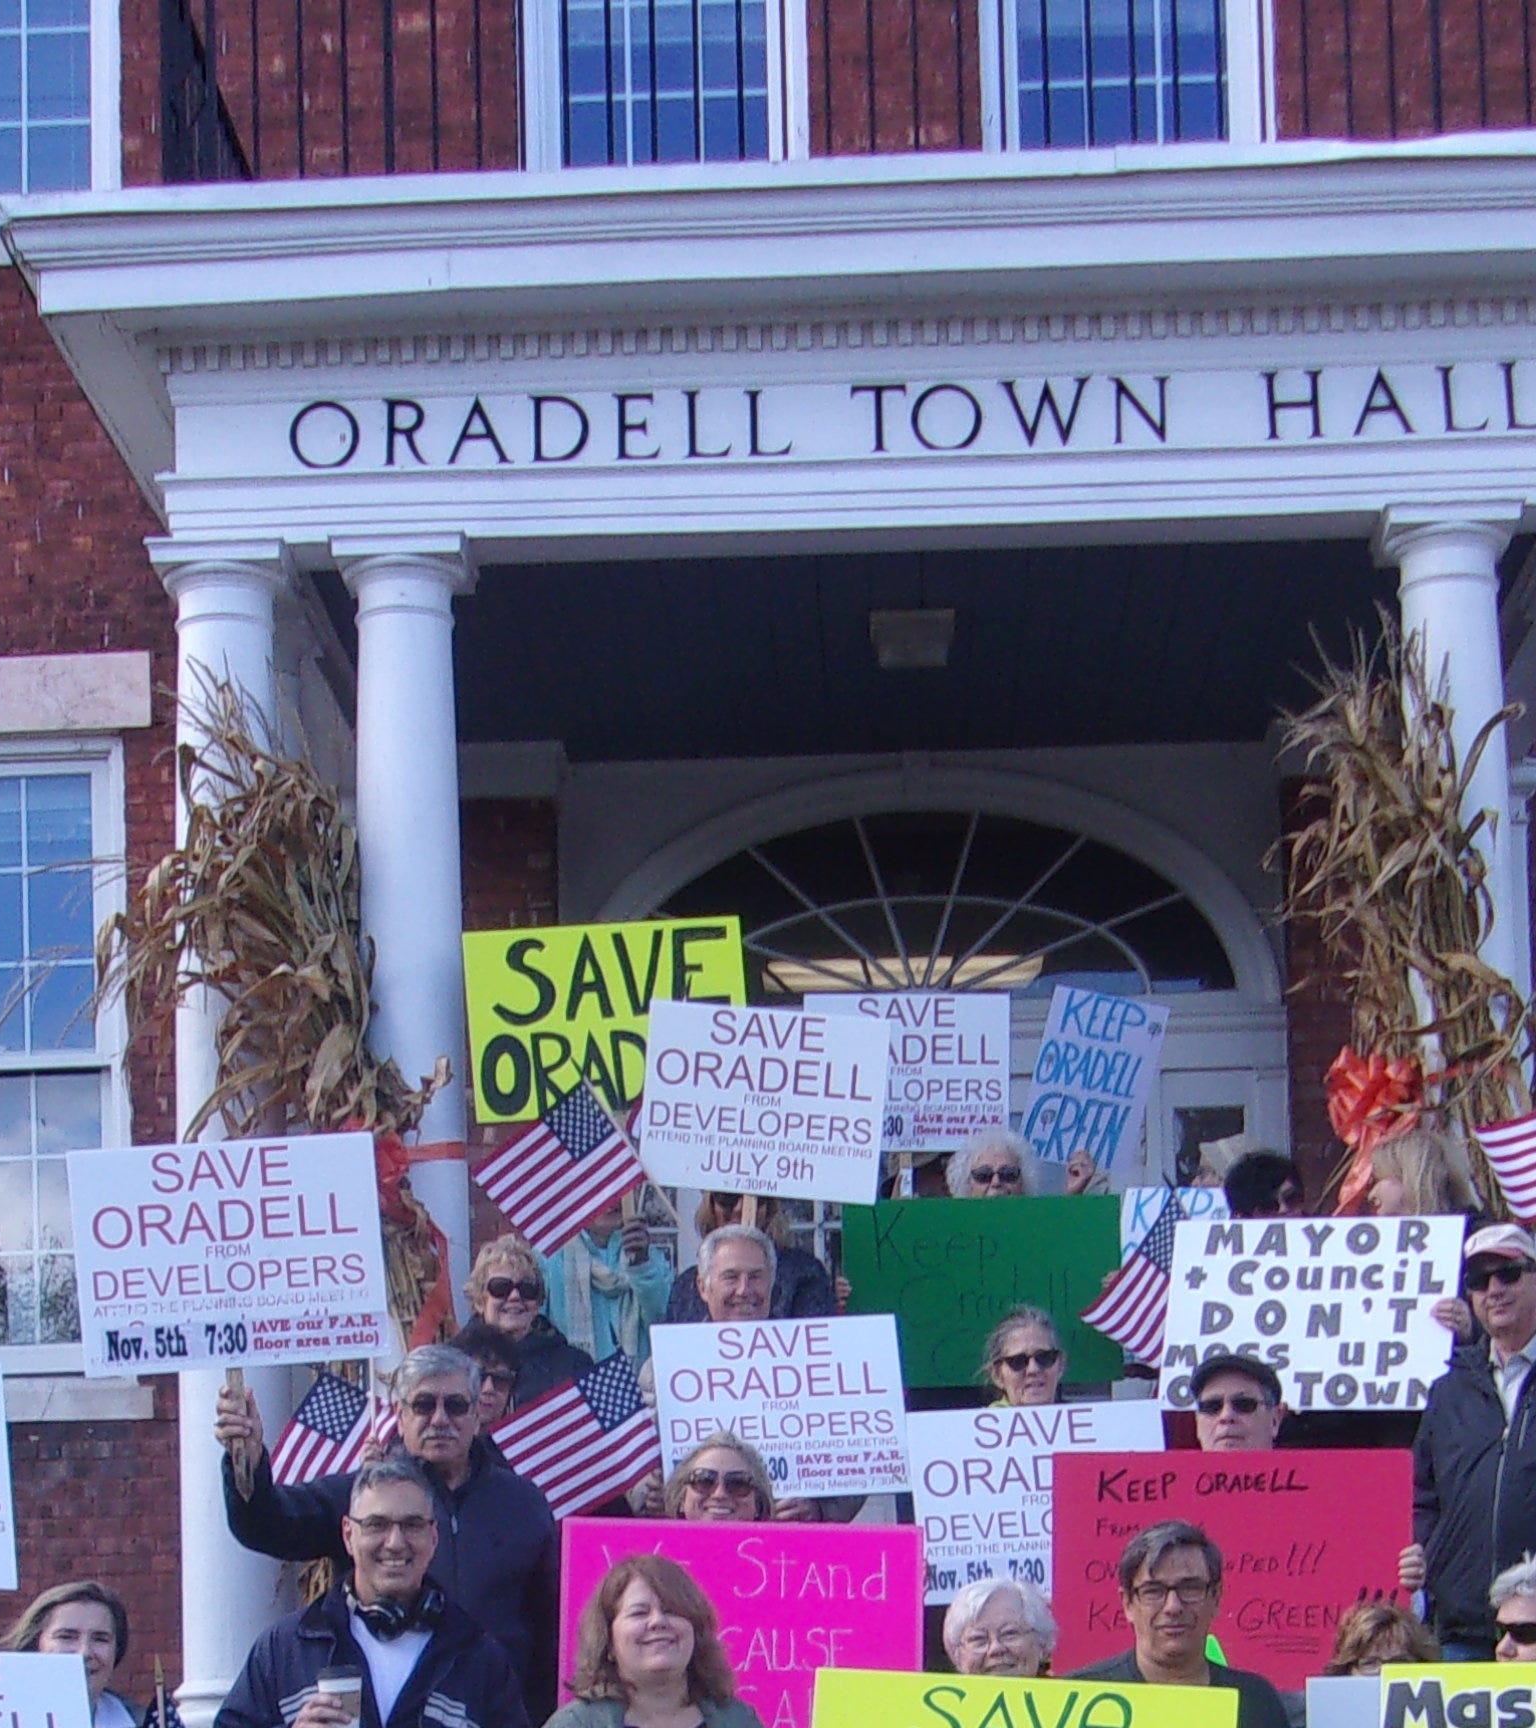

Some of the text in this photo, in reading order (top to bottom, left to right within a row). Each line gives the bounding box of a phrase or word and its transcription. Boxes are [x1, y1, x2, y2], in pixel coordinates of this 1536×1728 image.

[289, 389, 794, 470] ORADELL
[851, 376, 1171, 453] TOWN
[492, 926, 731, 1026] SAVE
[858, 997, 955, 1028] SAVE
[1059, 989, 1146, 1044] KEEP
[710, 1010, 826, 1053] SAVE
[889, 1034, 1000, 1066] DELL
[481, 1030, 646, 1116] ORAD
[656, 1049, 872, 1101] ORADELL
[1035, 1039, 1142, 1098] ORADELL
[744, 1094, 781, 1107] FROM
[888, 1079, 1002, 1101] LOPERS
[649, 1101, 872, 1144] DEVELOPERS
[1024, 1092, 1131, 1170] GREEN
[647, 1130, 872, 1159] ATTEND THE PLANNING BOARD MEETING
[152, 1144, 292, 1193] SAVE
[700, 1150, 814, 1181] JULY 9th
[92, 1192, 358, 1249] ORADELL
[1205, 1220, 1430, 1257] MAYOR
[205, 1243, 251, 1258] FROM
[92, 1254, 365, 1301] DEVELOPERS
[296, 1319, 323, 1331] our
[1200, 1299, 1418, 1338] DON'T
[106, 1323, 248, 1362] Nov. 5th 7:30
[296, 1336, 330, 1348] area
[718, 1323, 832, 1360] SAVE
[670, 1362, 887, 1403] ORADELL
[762, 1400, 800, 1411] FROM
[670, 1409, 894, 1443] DEVELOPERS
[805, 1436, 898, 1450] BOARD MEETING
[974, 1408, 1097, 1449] SAVE
[796, 1454, 832, 1465] SAVE
[836, 1455, 858, 1464] our
[924, 1455, 1052, 1497] ORAD
[1097, 1467, 1309, 1503] KEEP ORADELL
[925, 1509, 1052, 1543] DEVEL
[926, 1543, 1000, 1557] ATTEND THE
[927, 1564, 962, 1591] Nov.
[1088, 1602, 1134, 1632] KE
